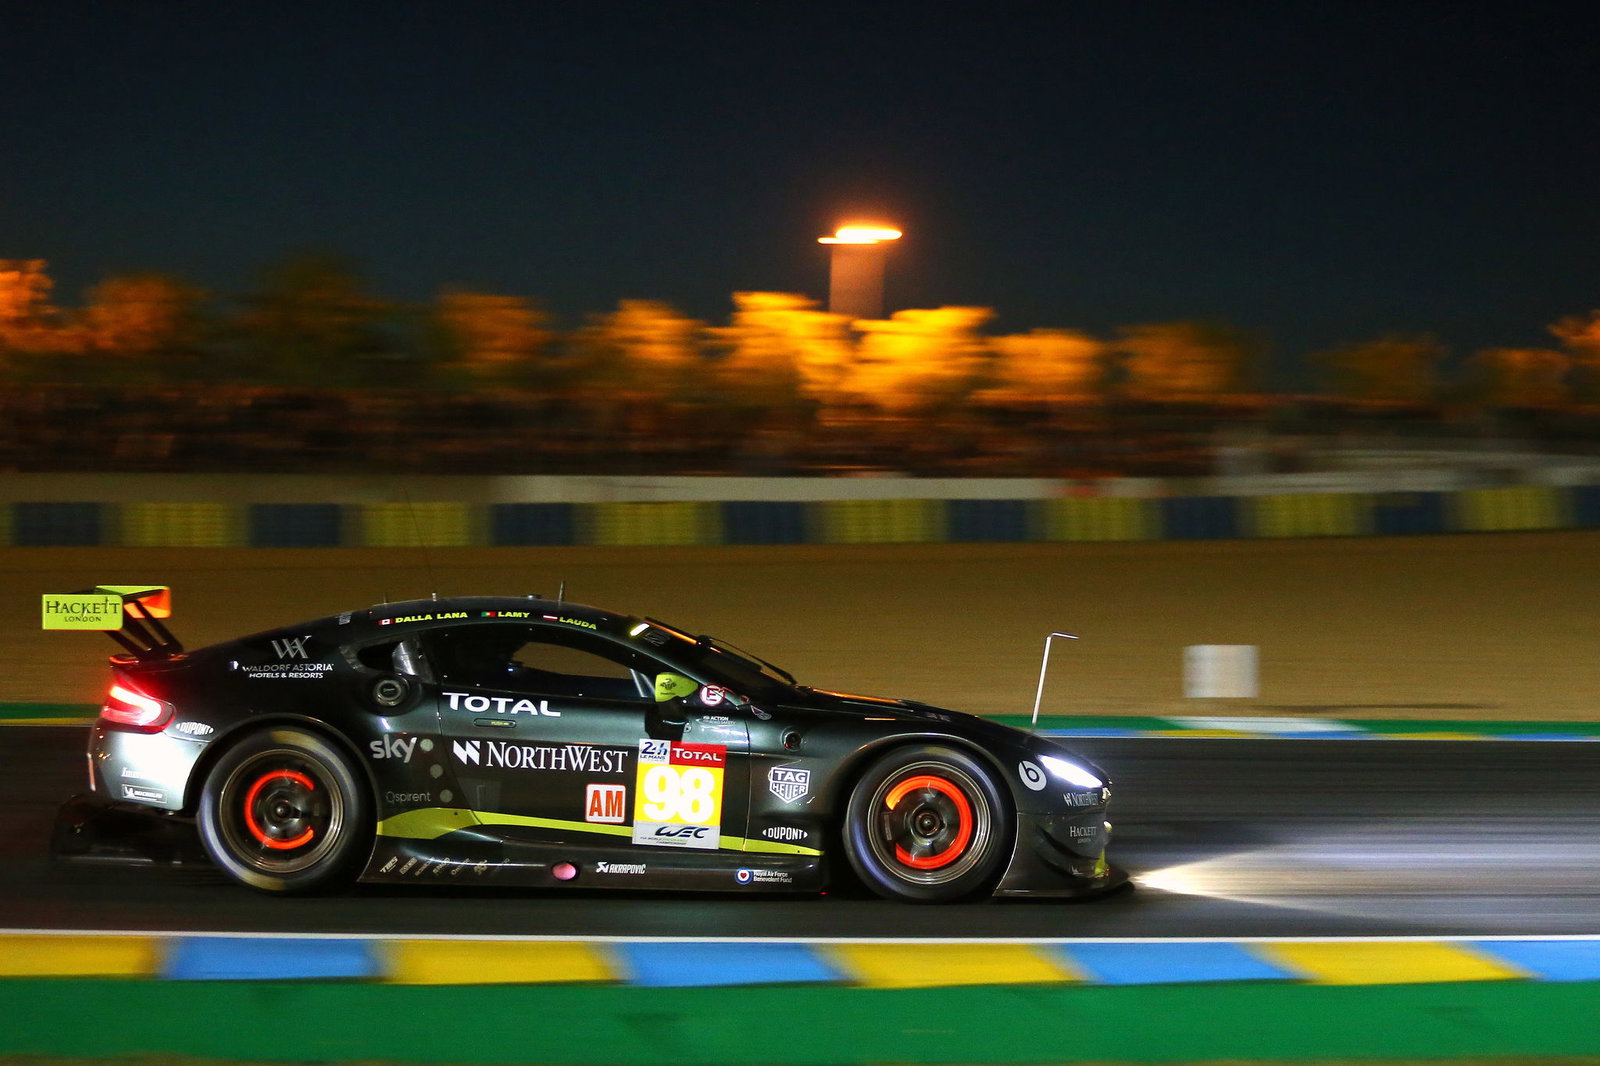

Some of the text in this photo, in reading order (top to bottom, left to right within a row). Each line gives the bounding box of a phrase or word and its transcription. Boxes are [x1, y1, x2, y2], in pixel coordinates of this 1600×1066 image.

[46, 598, 120, 614] HACKETT
[395, 614, 433, 623] DALLA
[559, 617, 597, 630] LAUDA
[242, 664, 290, 672] WALDORF
[442, 692, 561, 717] TOTAL
[180, 722, 210, 735] DUPONT
[370, 734, 417, 763] sky
[672, 748, 722, 762] TOTAL
[486, 741, 628, 773] NORTHWEST
[775, 770, 806, 783] TAG
[643, 766, 715, 823] 98
[772, 783, 805, 800] HEUER
[589, 790, 624, 817] AM
[655, 826, 709, 839] WEC
[768, 827, 803, 840] DUPONT
[1069, 826, 1097, 837] HACKETT
